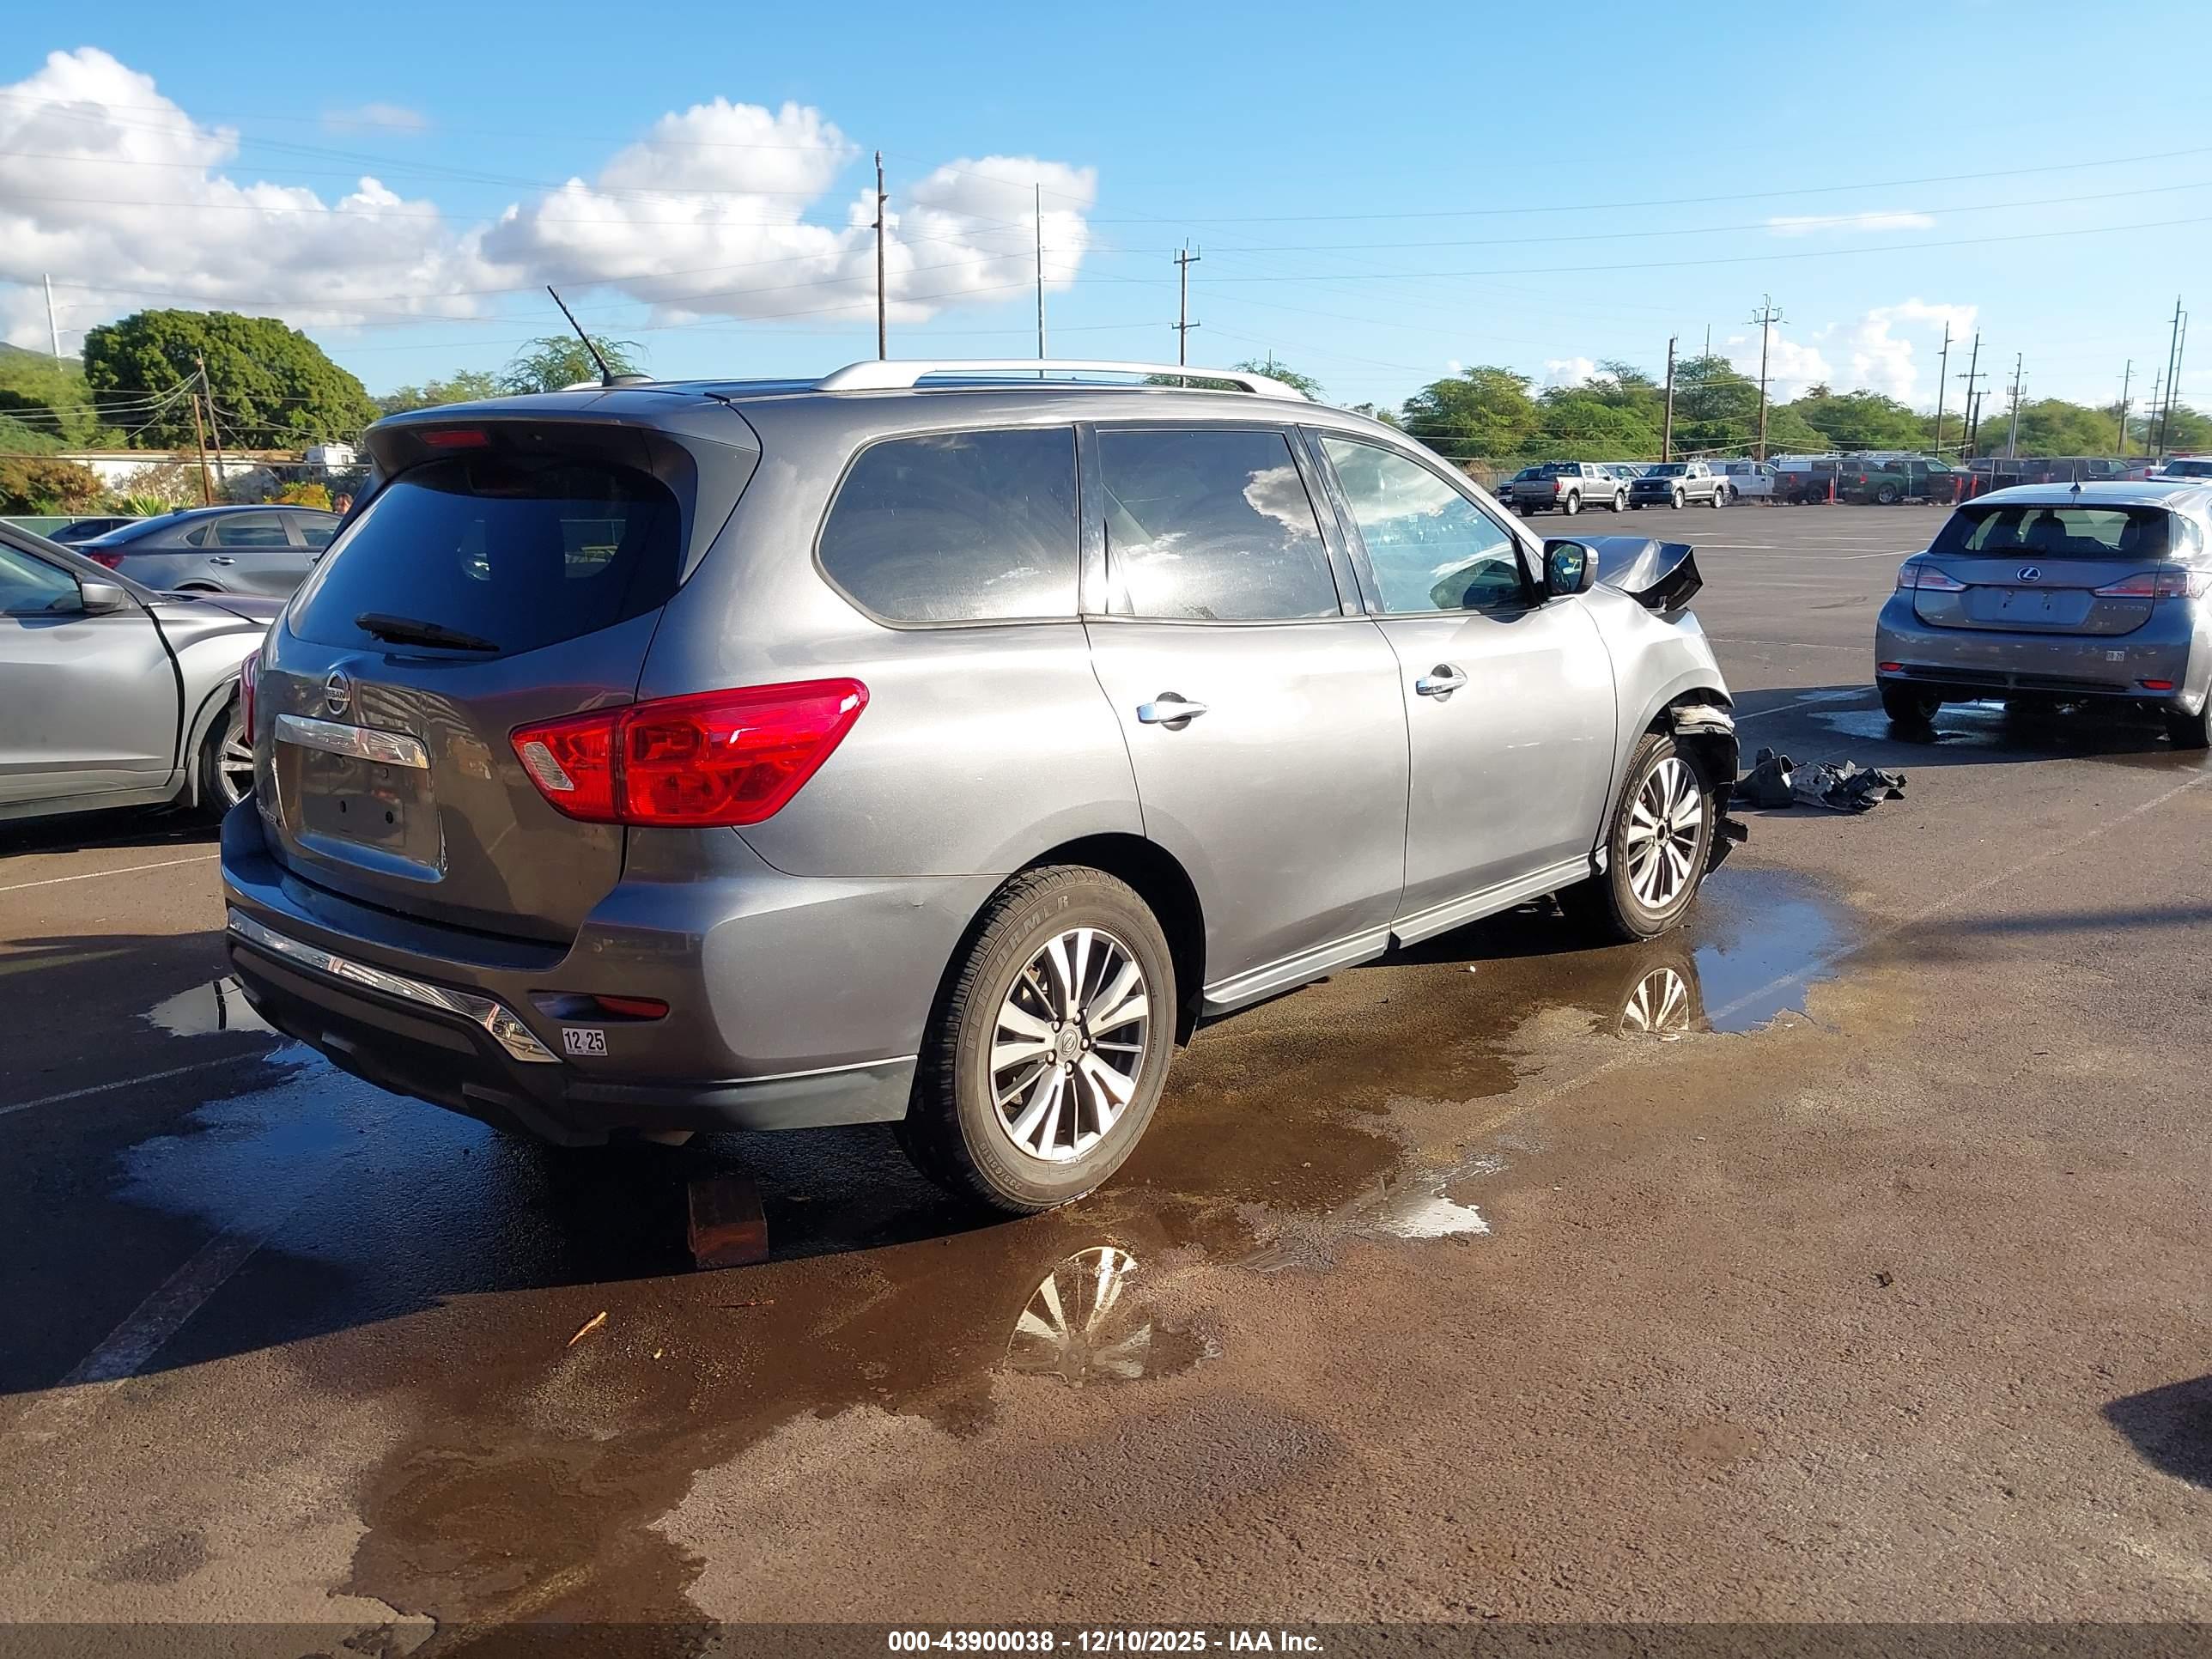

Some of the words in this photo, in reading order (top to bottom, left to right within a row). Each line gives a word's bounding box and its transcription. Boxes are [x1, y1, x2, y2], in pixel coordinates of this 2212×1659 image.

[564, 1030, 582, 1049] 12
[586, 1031, 605, 1051] 25
[979, 1142, 1023, 1190] 235/65R18
